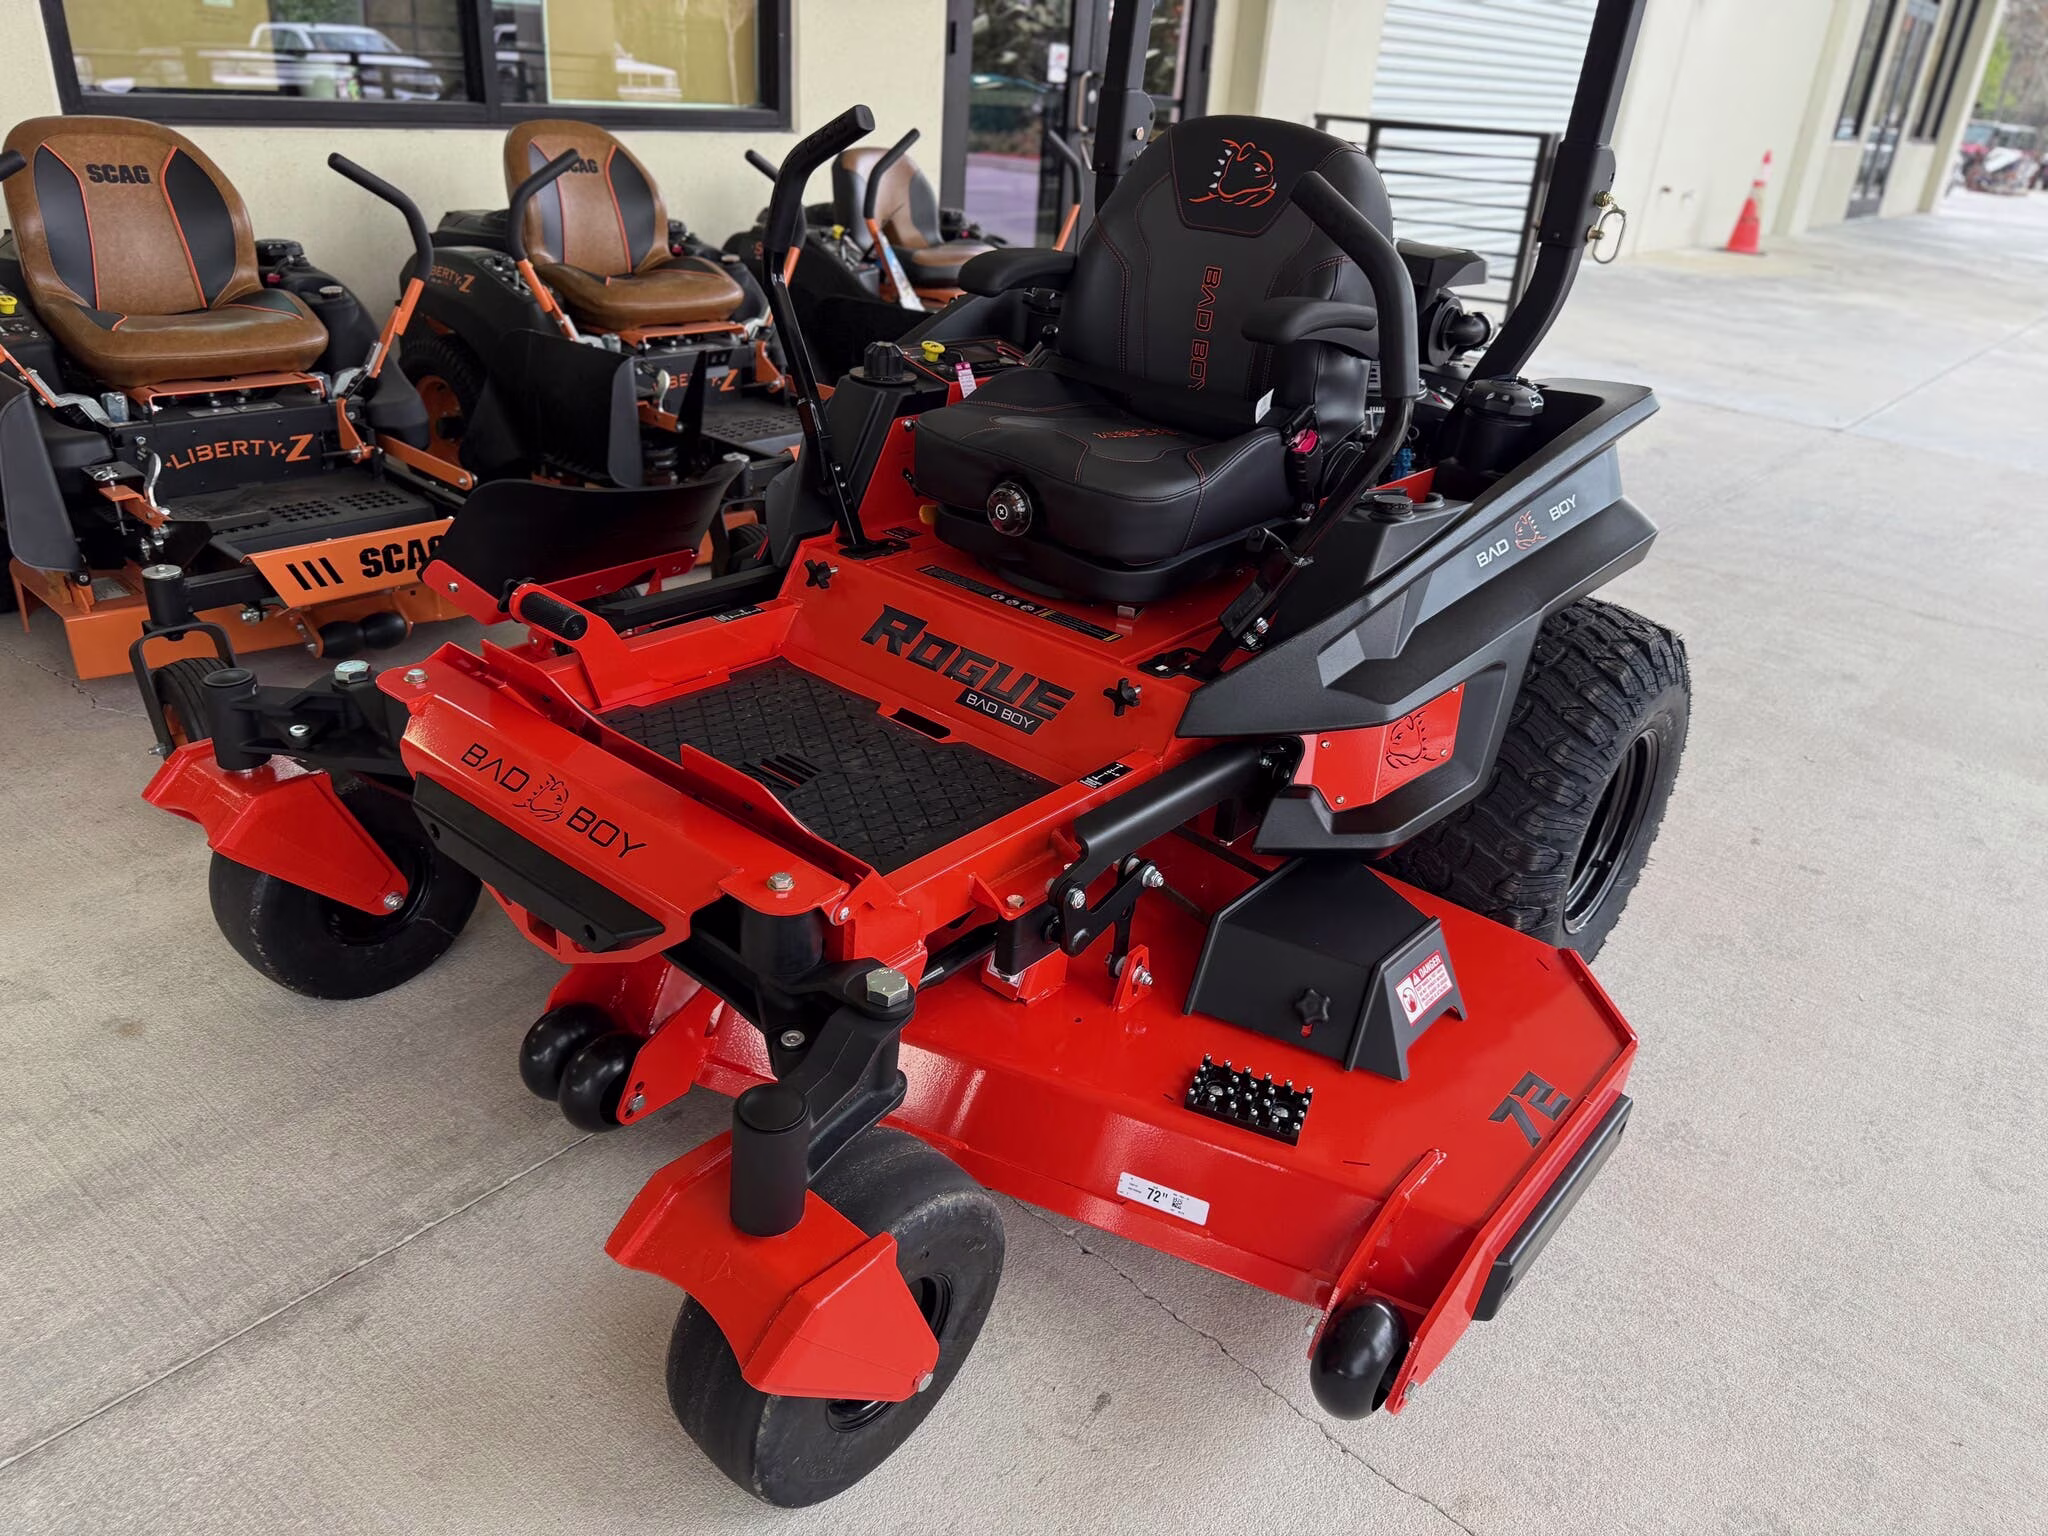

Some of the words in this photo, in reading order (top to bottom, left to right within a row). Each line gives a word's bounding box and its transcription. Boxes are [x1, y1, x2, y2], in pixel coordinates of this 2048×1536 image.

[86, 163, 153, 184] SCAG
[1194, 265, 1222, 332] BAD
[1476, 539, 1511, 568] BAD
[1548, 493, 1577, 521] BOY
[861, 604, 1076, 721] ROGUE
[966, 693, 998, 714] BAD
[1000, 708, 1036, 729] BOY
[460, 743, 531, 793] BAD
[565, 805, 648, 859] BOY
[1418, 954, 1442, 979] DANGER
[1488, 1070, 1572, 1148] 72
